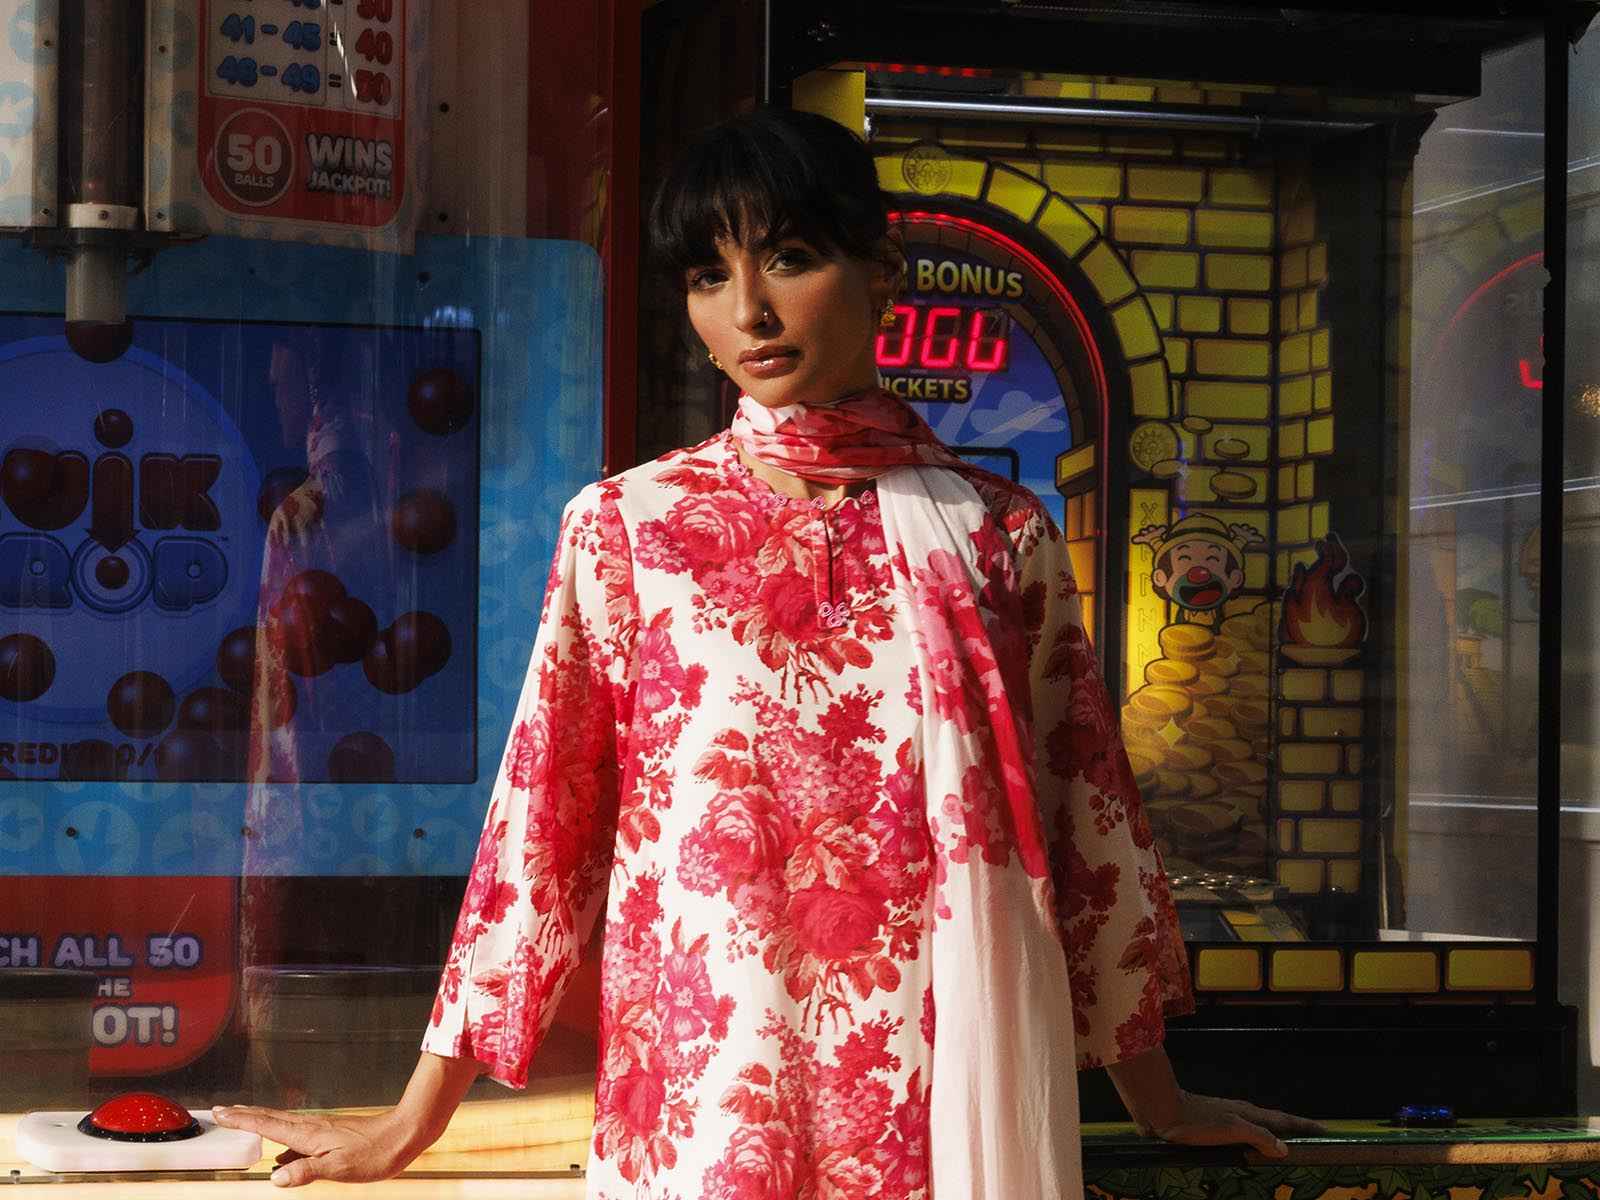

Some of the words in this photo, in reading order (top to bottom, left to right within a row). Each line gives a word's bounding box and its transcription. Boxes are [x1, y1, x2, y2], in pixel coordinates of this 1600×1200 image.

[220, 13, 255, 45] 41
[282, 20, 321, 51] 45
[355, 28, 393, 65] 40
[226, 133, 283, 174] 50
[305, 134, 393, 176] WINS
[234, 173, 275, 188] BALLS
[309, 171, 391, 198] JACKPOT!
[916, 258, 1024, 298] BONUS
[54, 937, 133, 967] ALL
[150, 936, 200, 967] 50
[98, 978, 130, 997] HE
[92, 1005, 176, 1045] OT!
